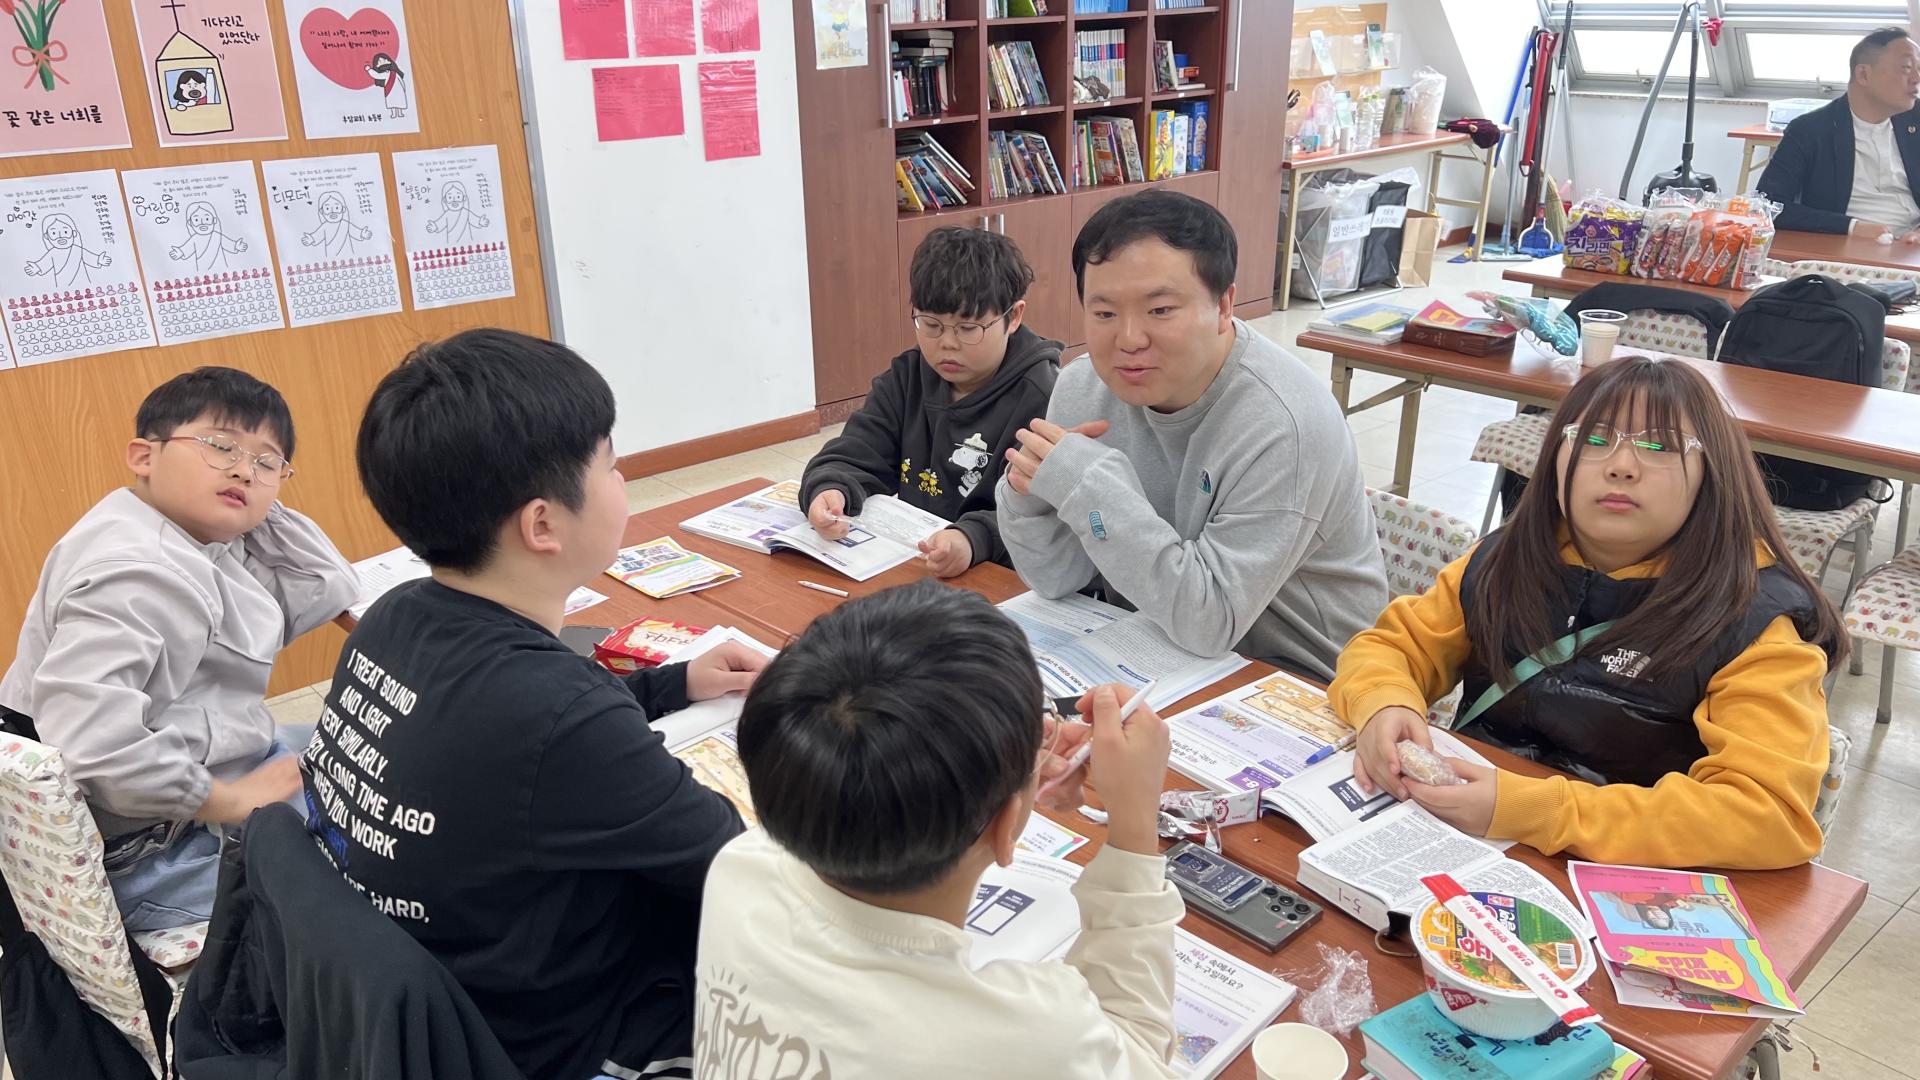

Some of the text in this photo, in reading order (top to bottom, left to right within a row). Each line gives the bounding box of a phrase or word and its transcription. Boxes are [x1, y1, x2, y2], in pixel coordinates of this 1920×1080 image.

[201, 15, 244, 28] 기다리고
[219, 30, 260, 45] 있었단다
[2, 105, 102, 128] 꽃 같은 너희를
[135, 201, 180, 217] 어린양
[273, 189, 311, 204] 디모데
[347, 648, 417, 716] I TREAT SOUND
[339, 685, 392, 739] AND LIGHT
[337, 724, 389, 783] SIMILARLY.
[328, 756, 356, 798] LONG
[356, 780, 388, 822] TIME
[390, 804, 436, 836] AGO
[327, 793, 349, 830] YOU
[350, 814, 399, 860] WORK
[1174, 948, 1244, 991] 리는 누구일까요?
[1190, 948, 1237, 976] 세상 속에서
